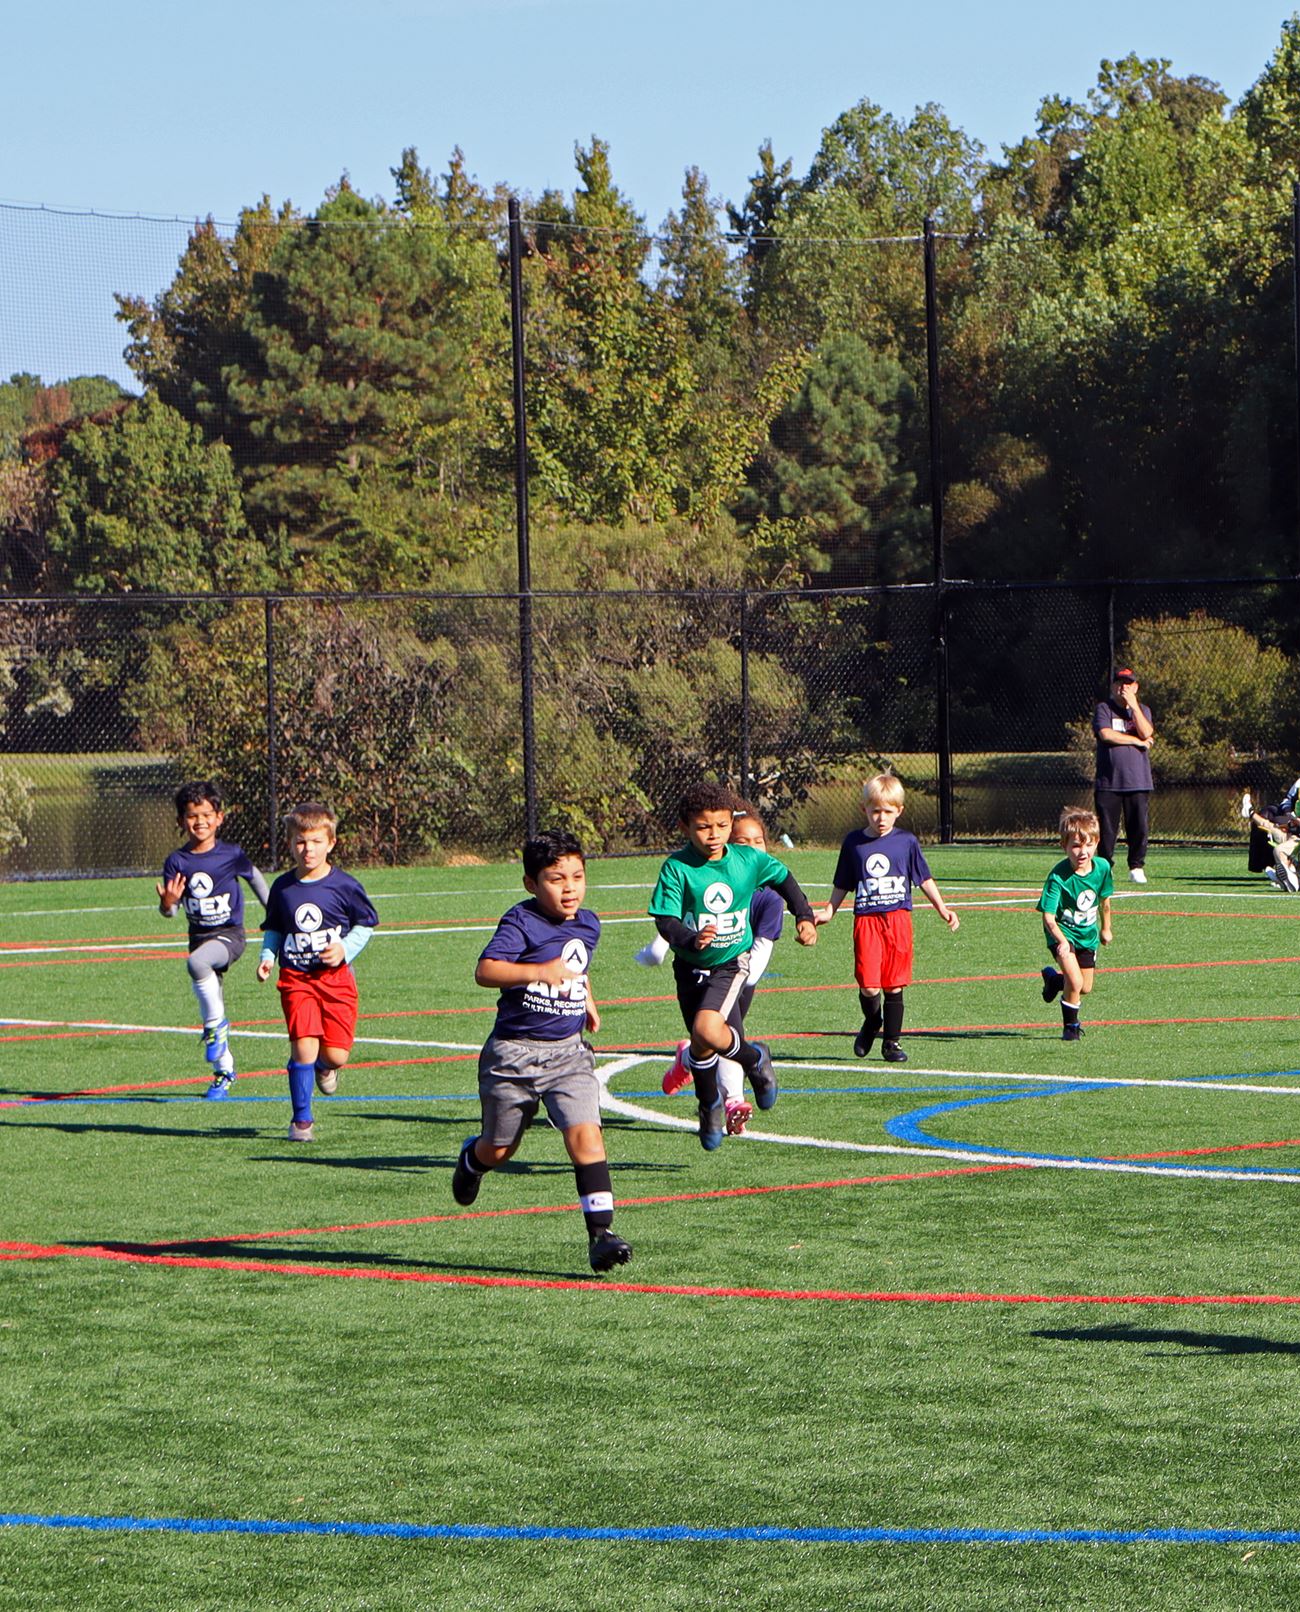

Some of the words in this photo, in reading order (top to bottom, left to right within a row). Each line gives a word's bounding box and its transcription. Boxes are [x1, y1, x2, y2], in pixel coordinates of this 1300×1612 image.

[856, 876, 906, 898] APEX
[1061, 905, 1099, 926] APE
[526, 975, 589, 1001] APE
